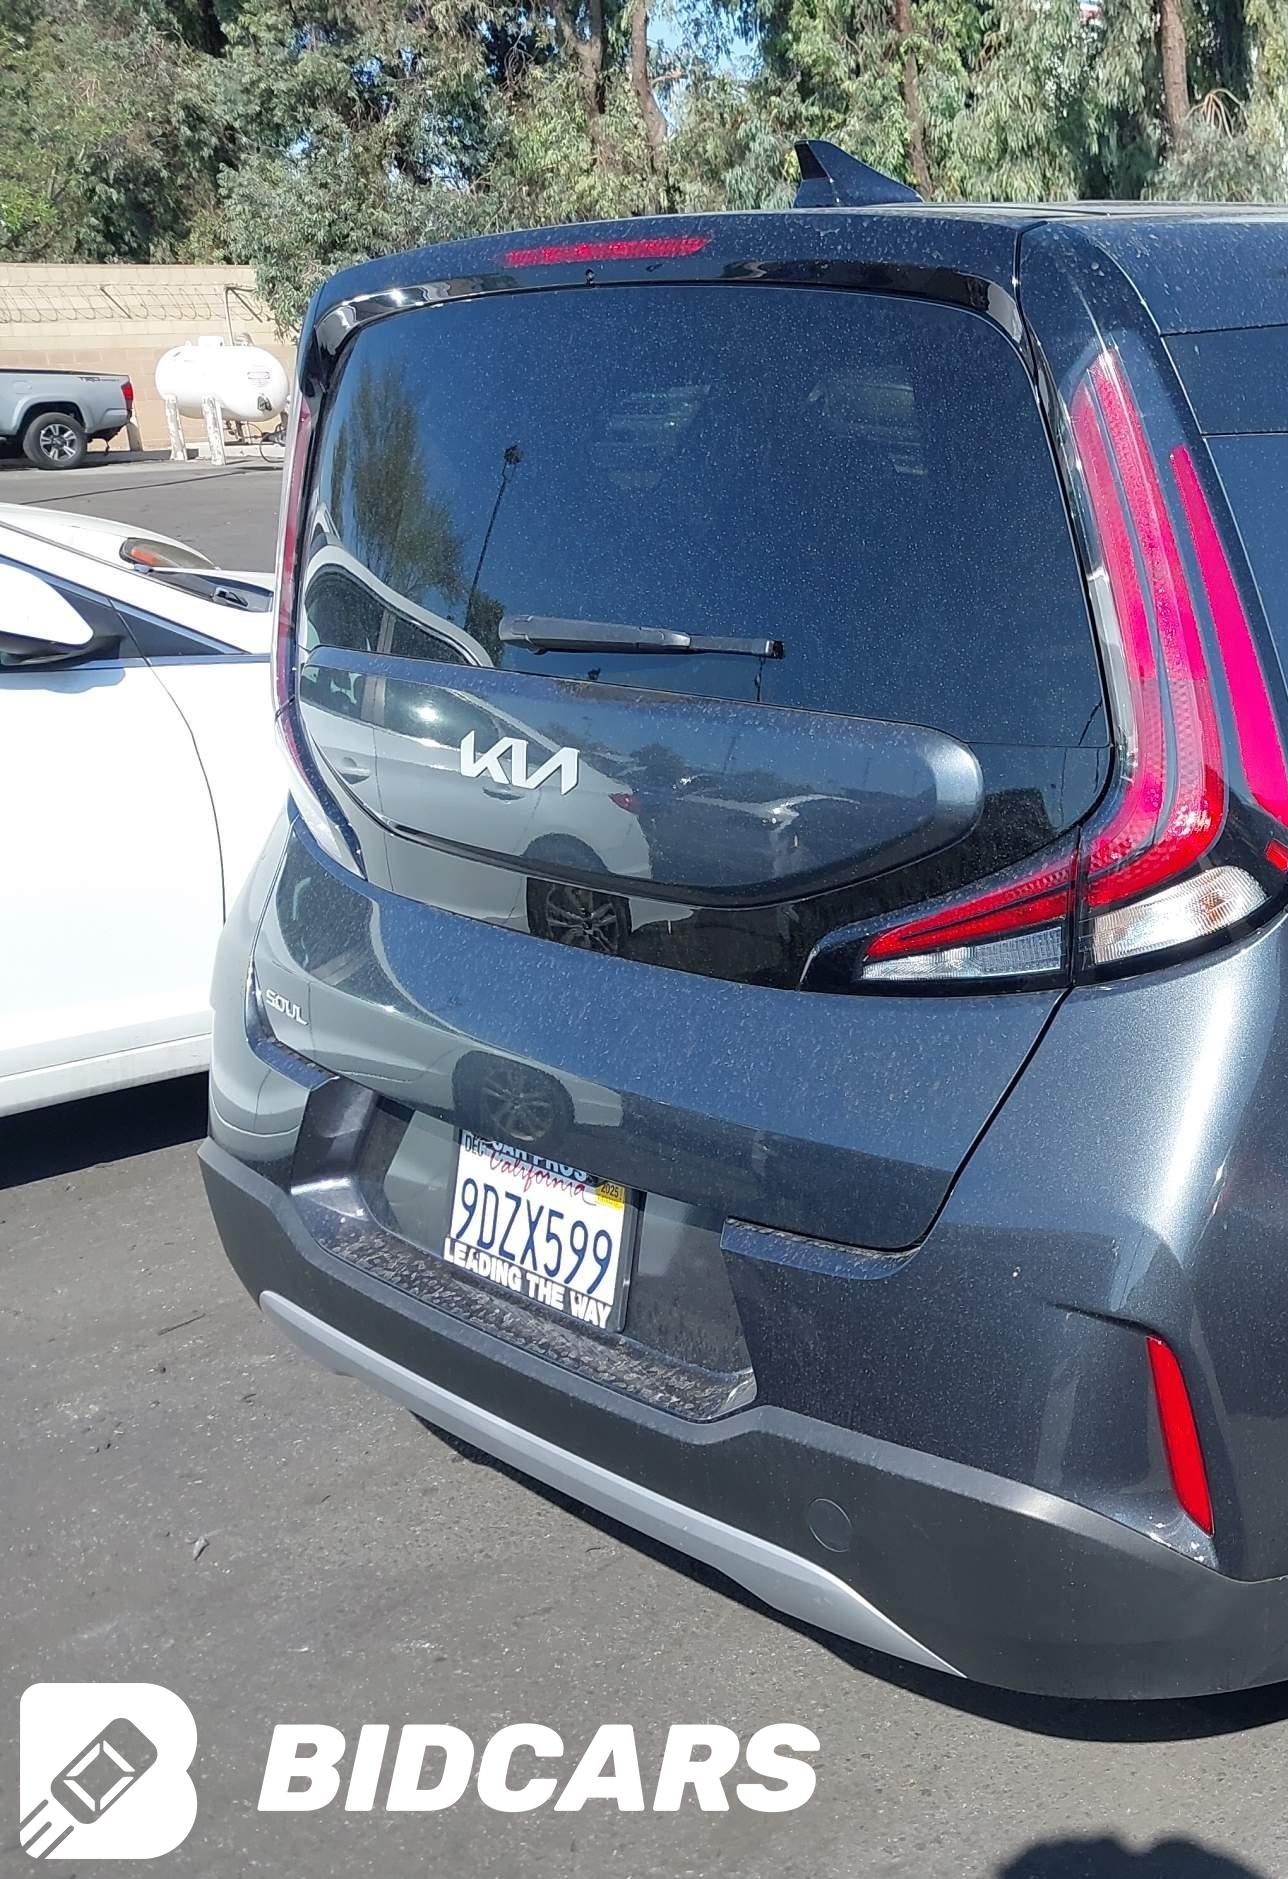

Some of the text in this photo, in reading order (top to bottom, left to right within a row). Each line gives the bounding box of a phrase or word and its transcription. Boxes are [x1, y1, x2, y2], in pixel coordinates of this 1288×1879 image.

[460, 730, 579, 795] KIA
[265, 989, 308, 1025] SOUL
[600, 1183, 619, 1199] 2025
[455, 1177, 613, 1295] 9DZX599
[444, 1237, 614, 1329] LEADING THE WAY
